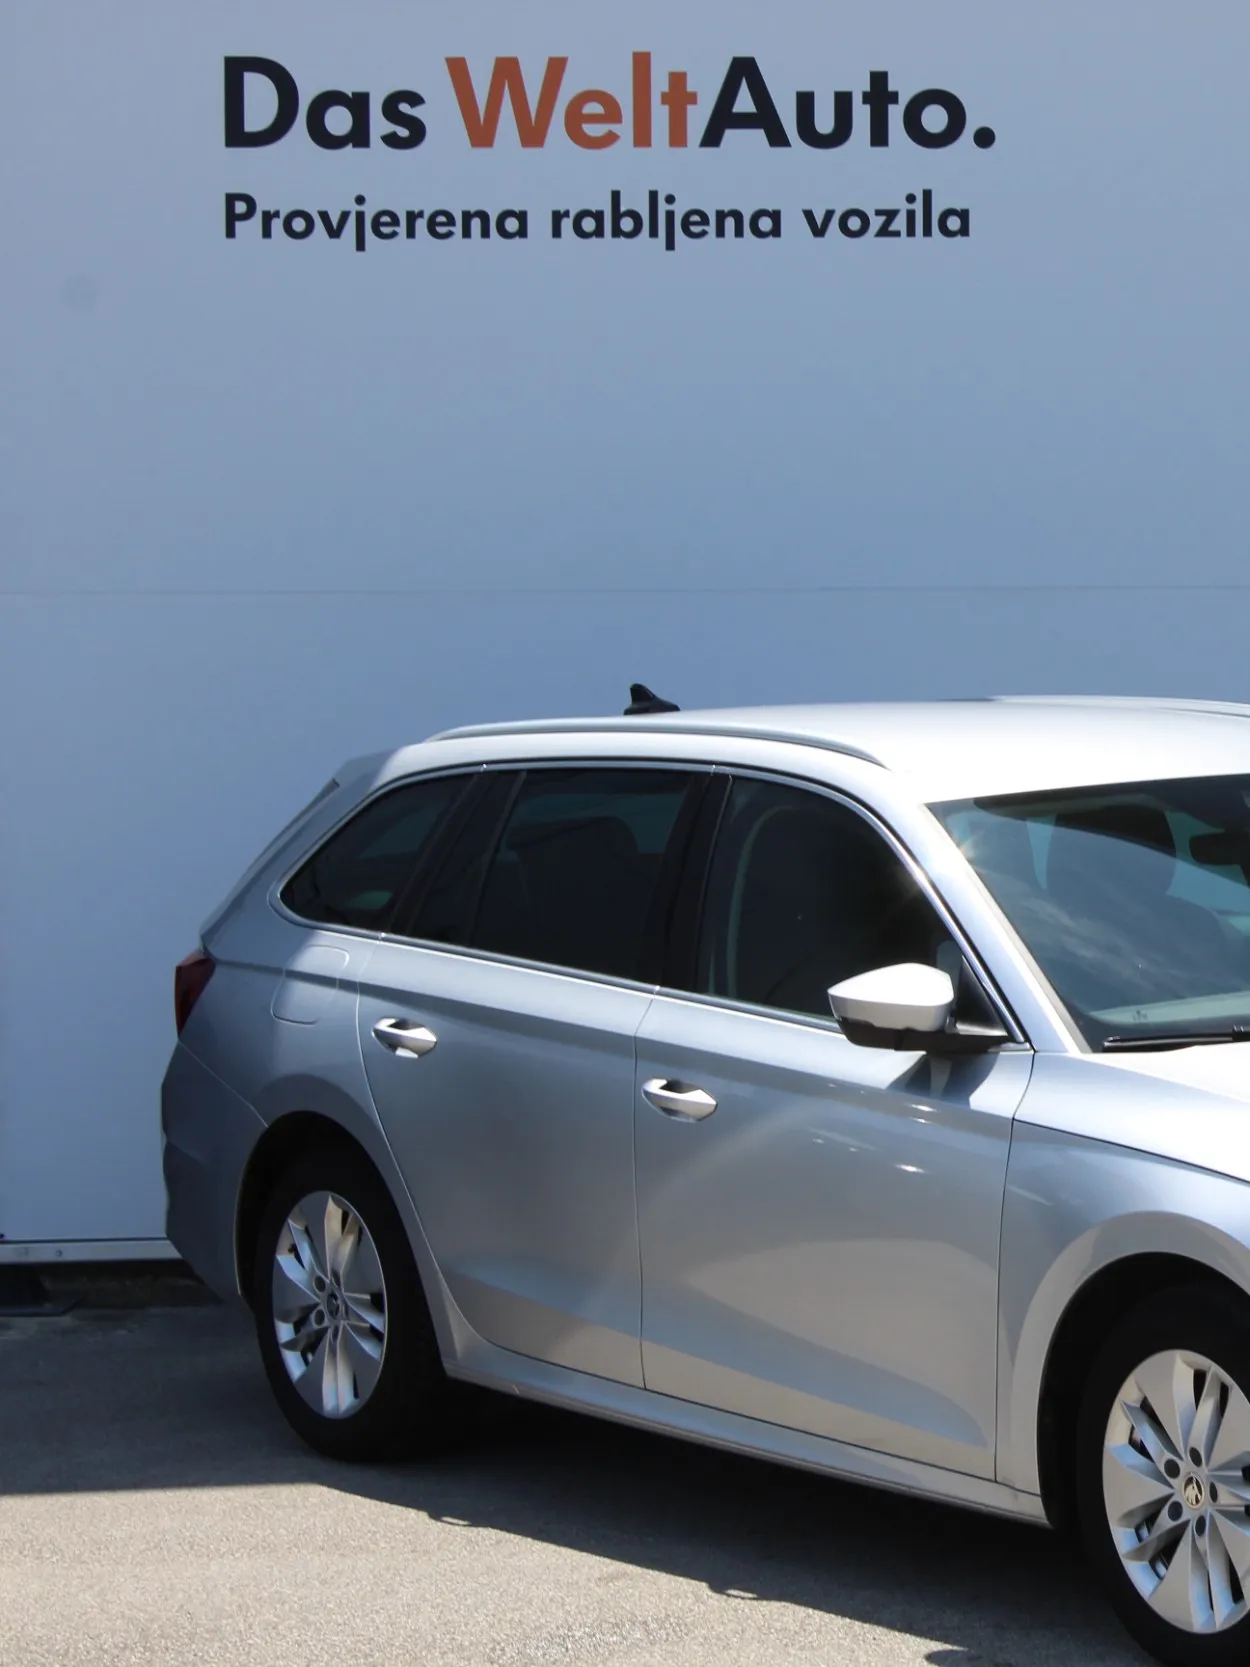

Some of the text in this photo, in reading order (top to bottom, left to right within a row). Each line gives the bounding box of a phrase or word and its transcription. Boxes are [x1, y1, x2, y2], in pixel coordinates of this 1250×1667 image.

[224, 52, 996, 150] Das WeltAuto.
[225, 189, 970, 252] Provjerena rabljena vozila
